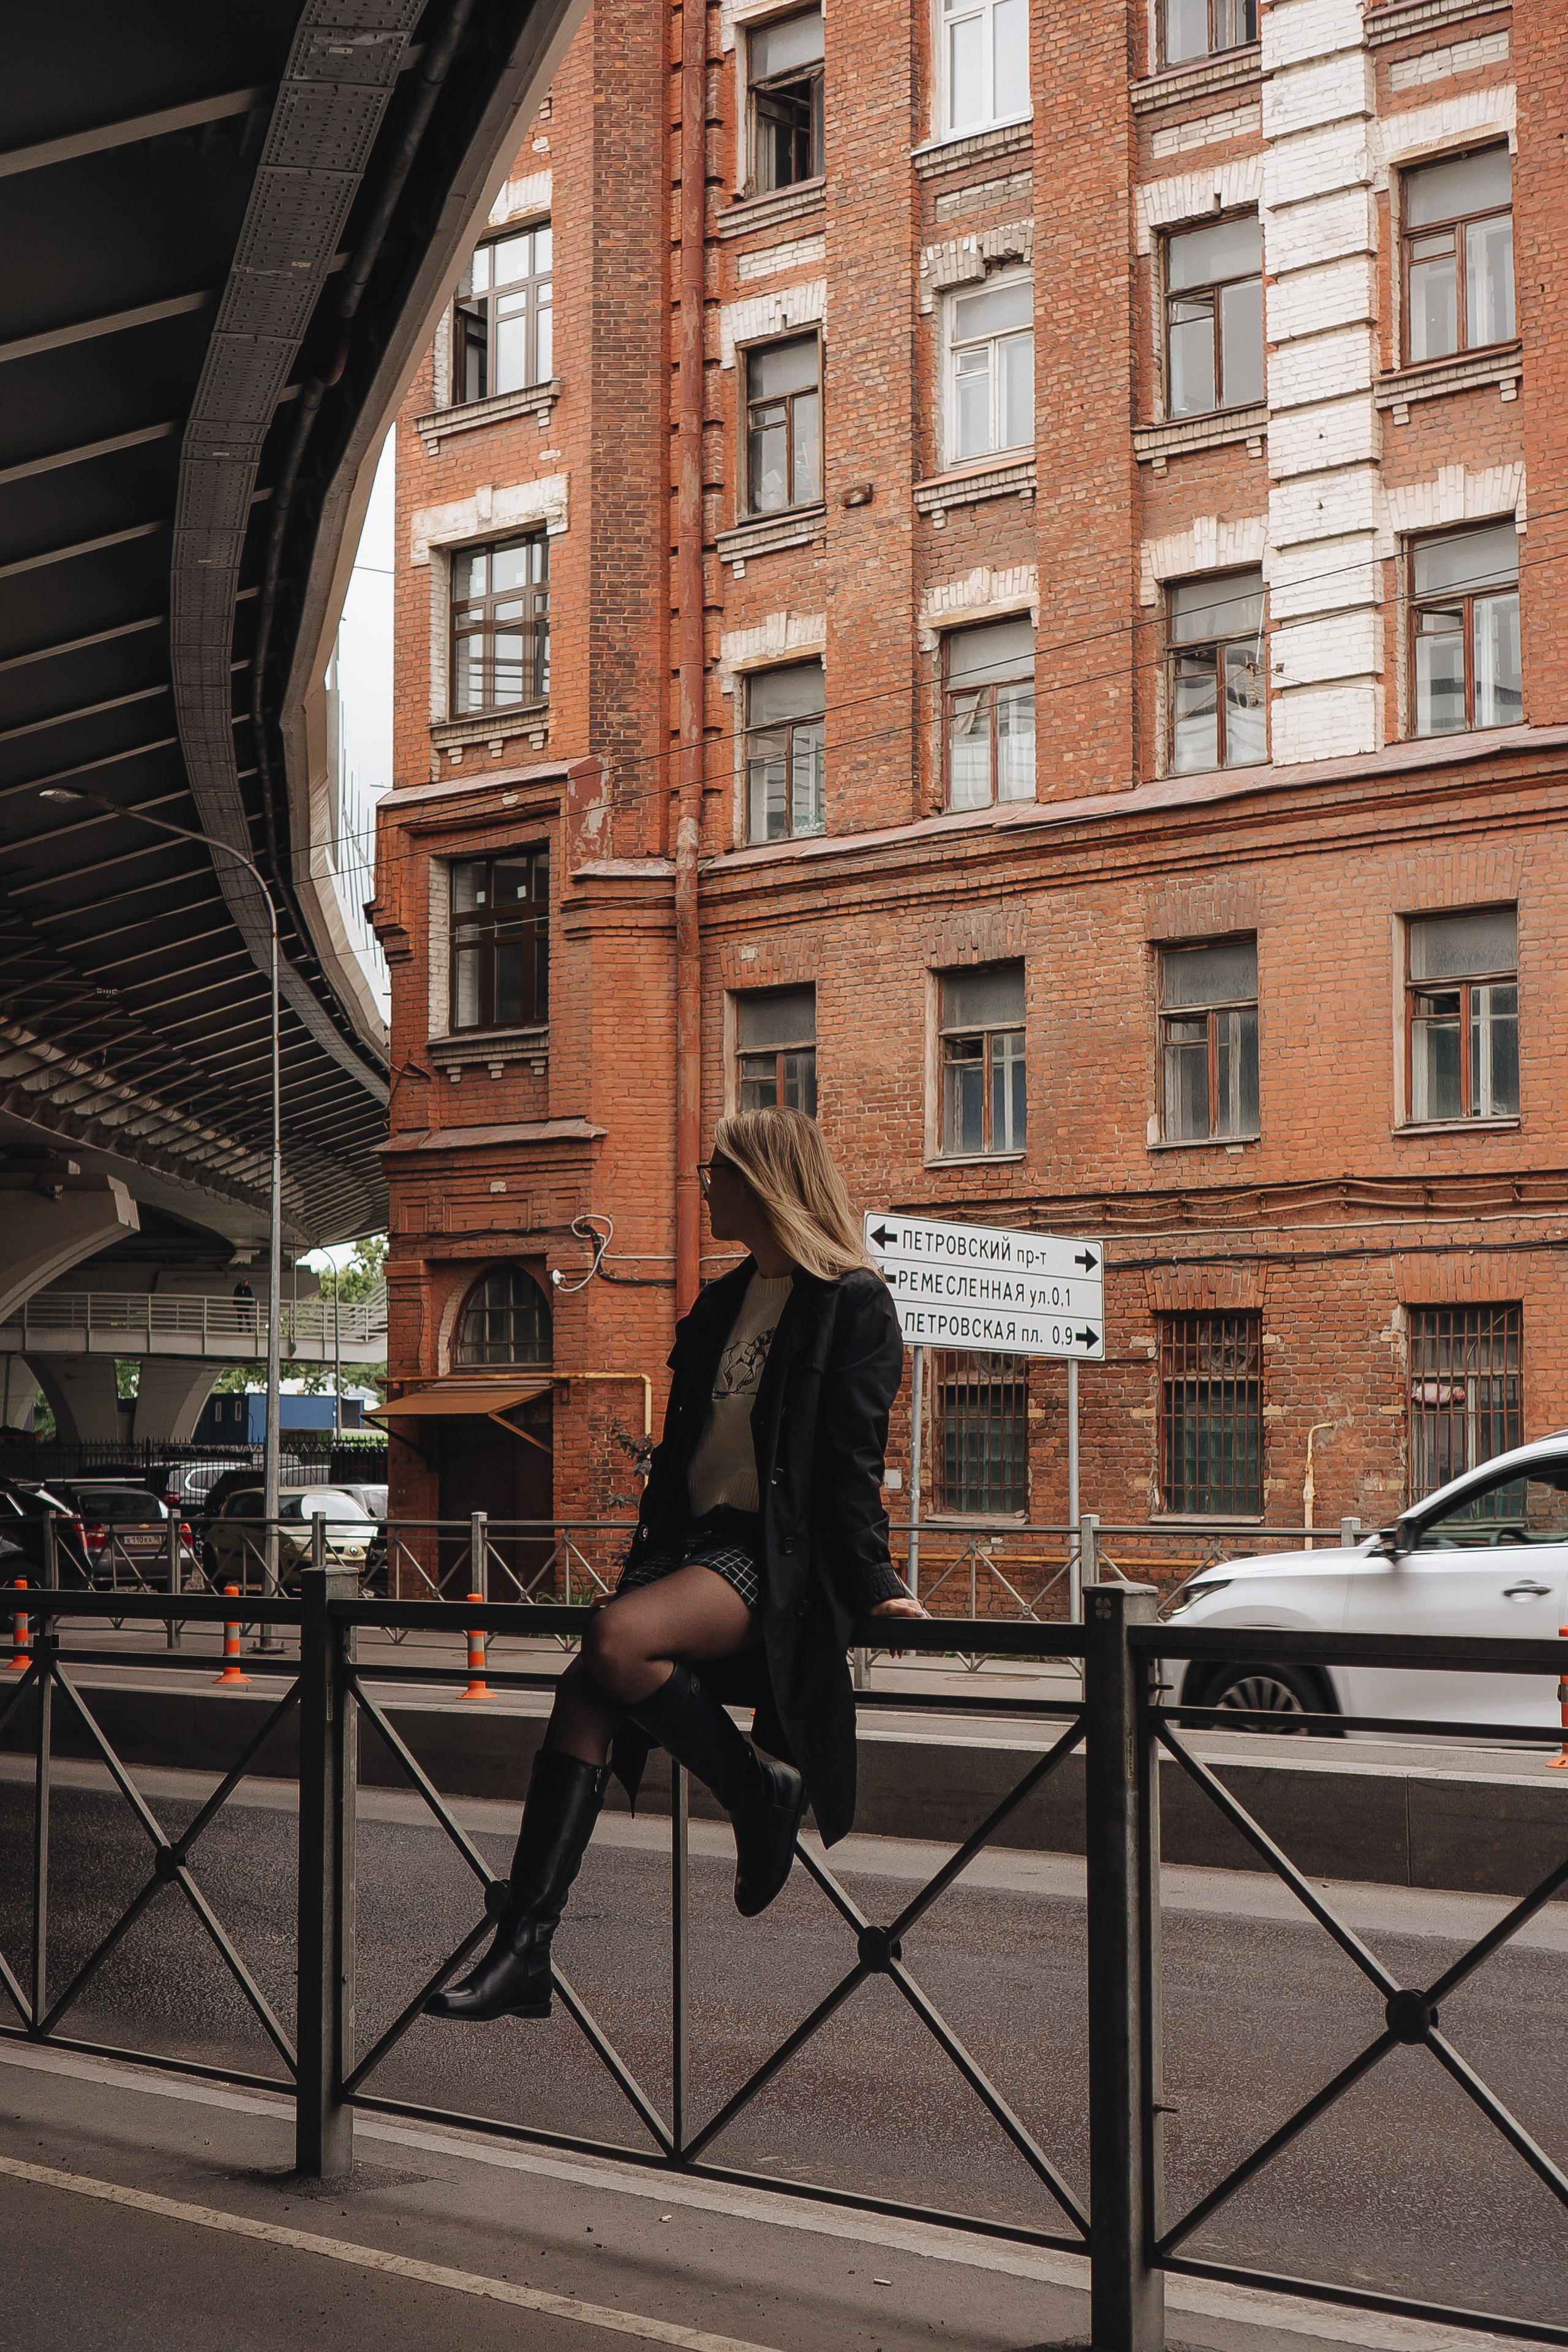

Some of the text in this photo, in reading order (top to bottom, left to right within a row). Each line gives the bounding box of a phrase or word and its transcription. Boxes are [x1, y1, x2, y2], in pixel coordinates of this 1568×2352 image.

[903, 1230, 1047, 1268] ПЕТРОВСКИЙ пр-т
[899, 1270, 1024, 1302] РЕМЕСЛЕННАЯ
[905, 1312, 1072, 1346] ПЕТРОВСКАЯ пл. 0,9
